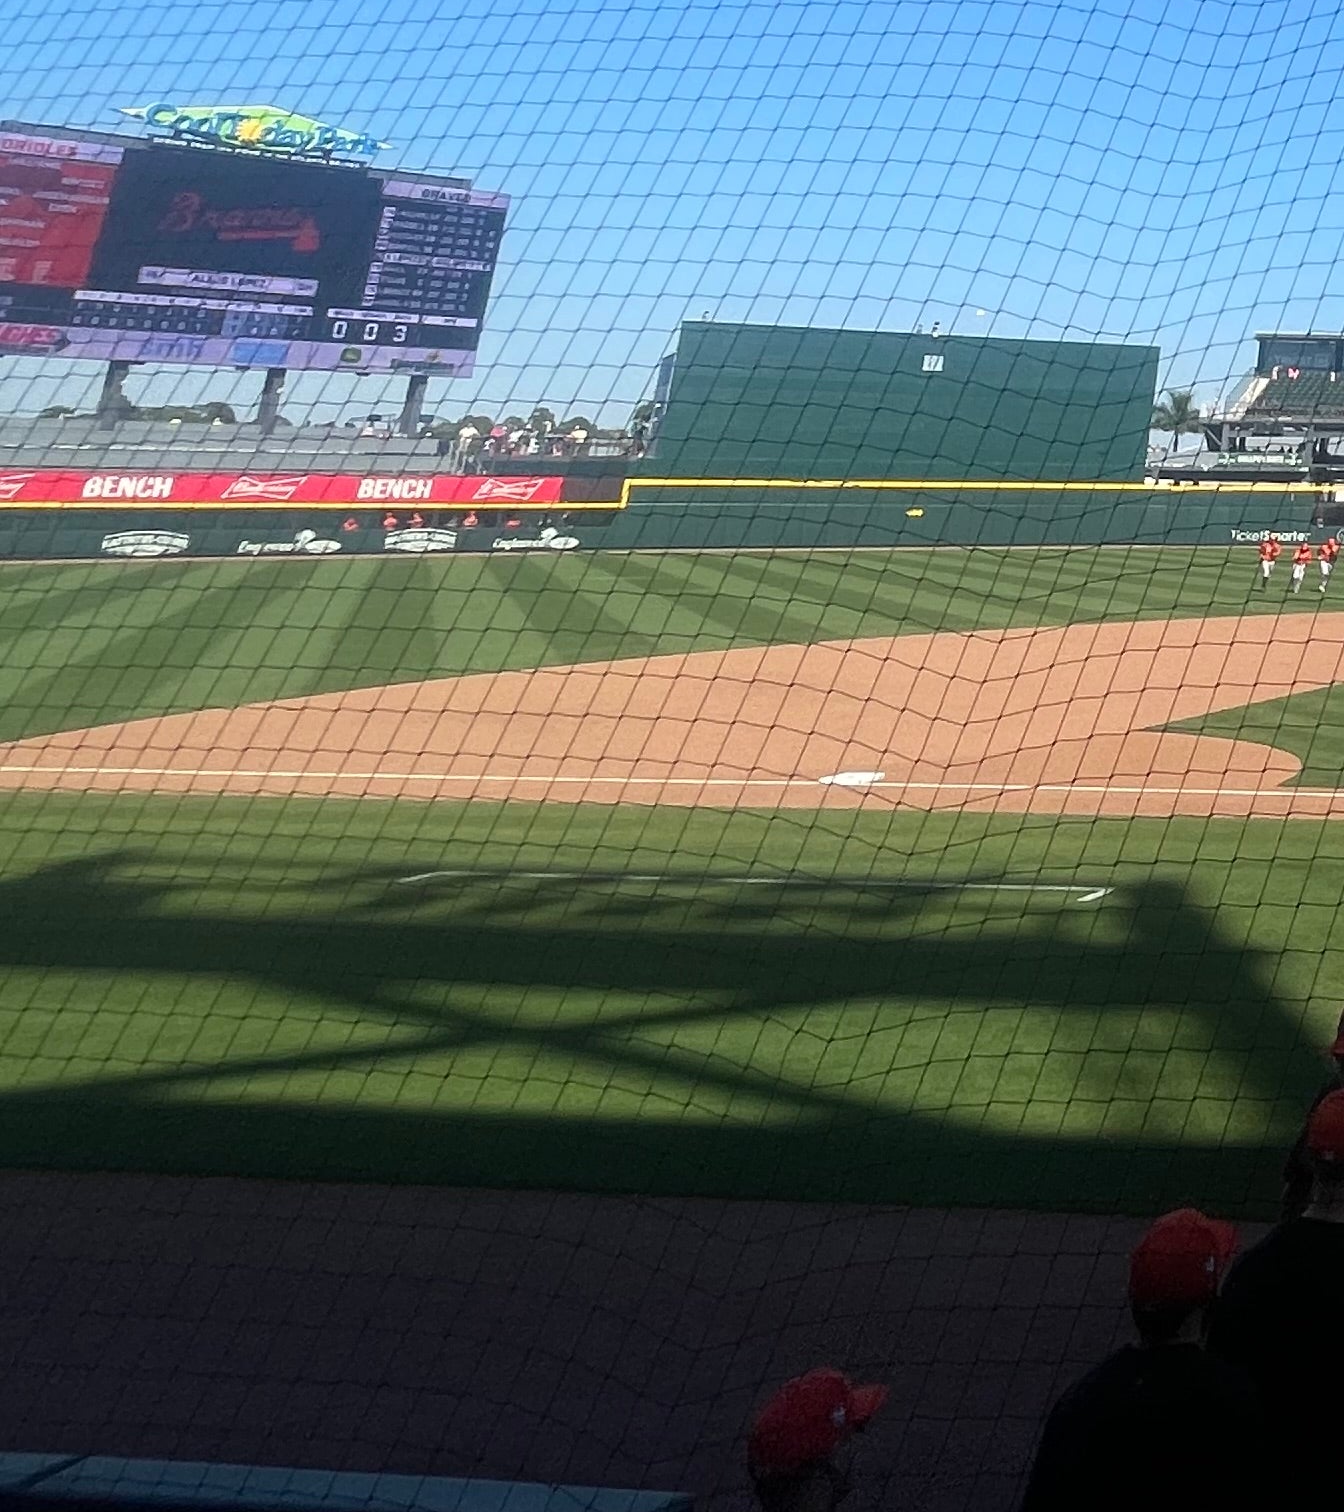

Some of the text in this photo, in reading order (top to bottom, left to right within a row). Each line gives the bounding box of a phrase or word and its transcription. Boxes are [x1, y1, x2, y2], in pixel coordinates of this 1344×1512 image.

[315, 126, 378, 154] Park
[332, 321, 408, 342] 0 0 3
[82, 476, 175, 497] BENCH
[357, 478, 434, 499] BENCH
